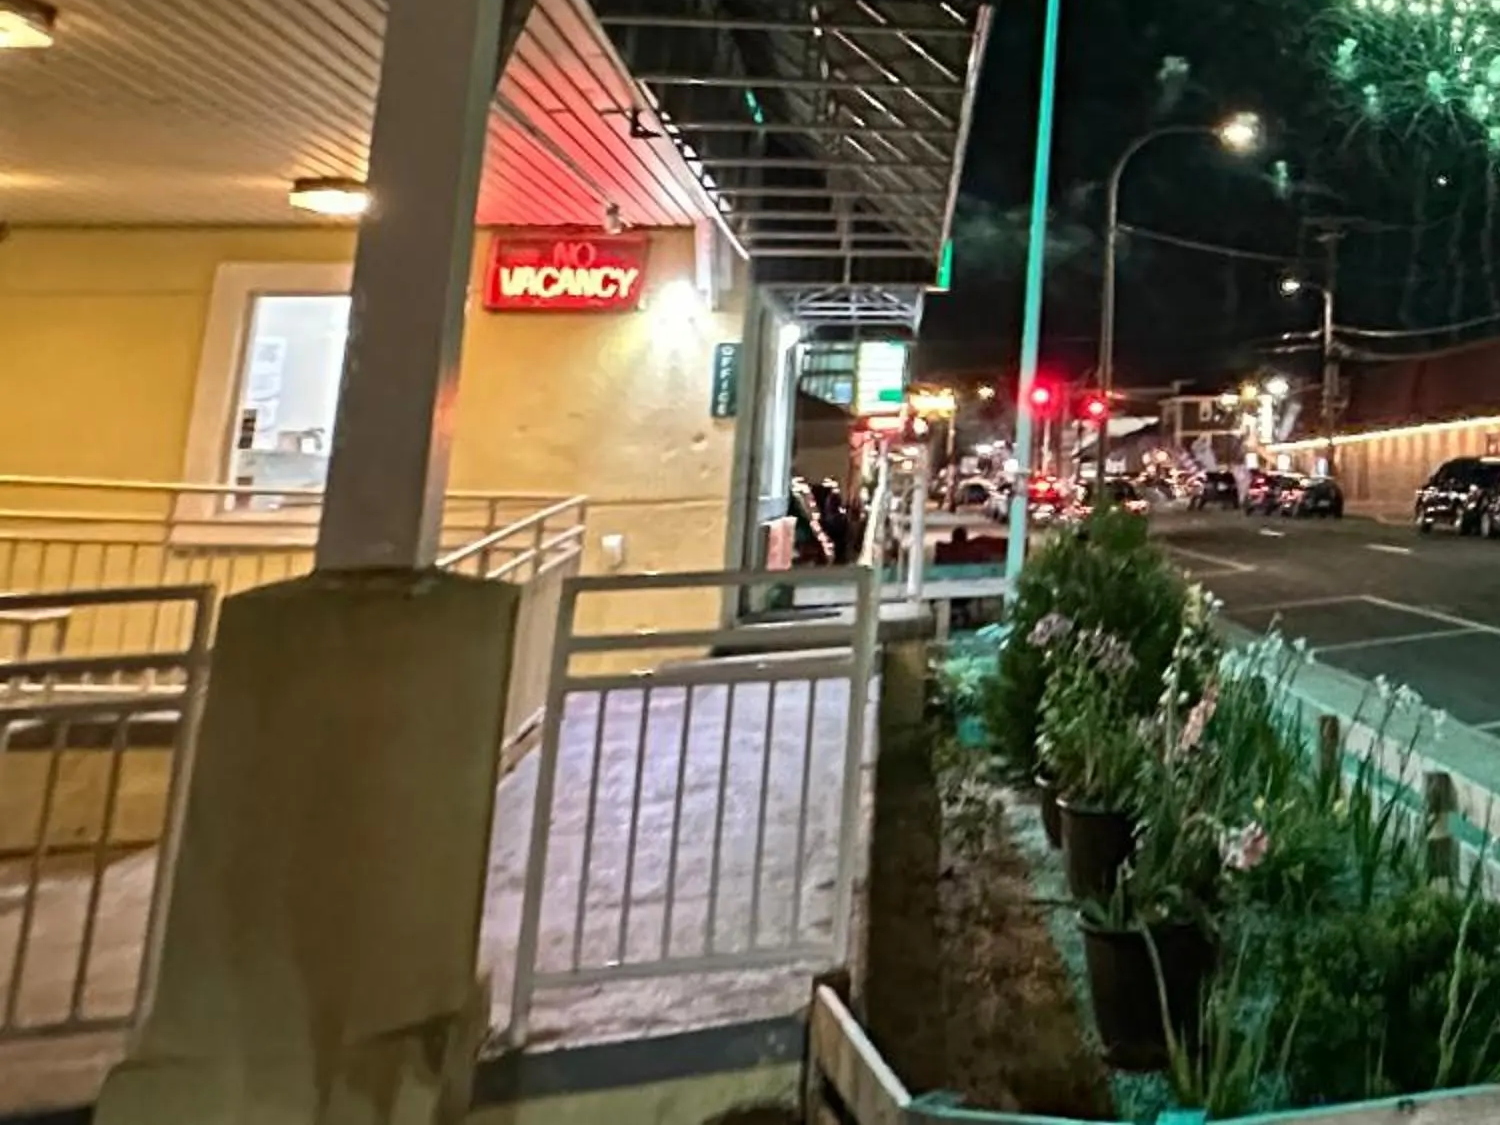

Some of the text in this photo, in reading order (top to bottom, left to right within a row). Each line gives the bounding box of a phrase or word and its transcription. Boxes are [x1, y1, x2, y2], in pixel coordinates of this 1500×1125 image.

[553, 242, 596, 267] NO
[500, 266, 639, 298] VACANCY
[718, 345, 735, 415] OFFICE
